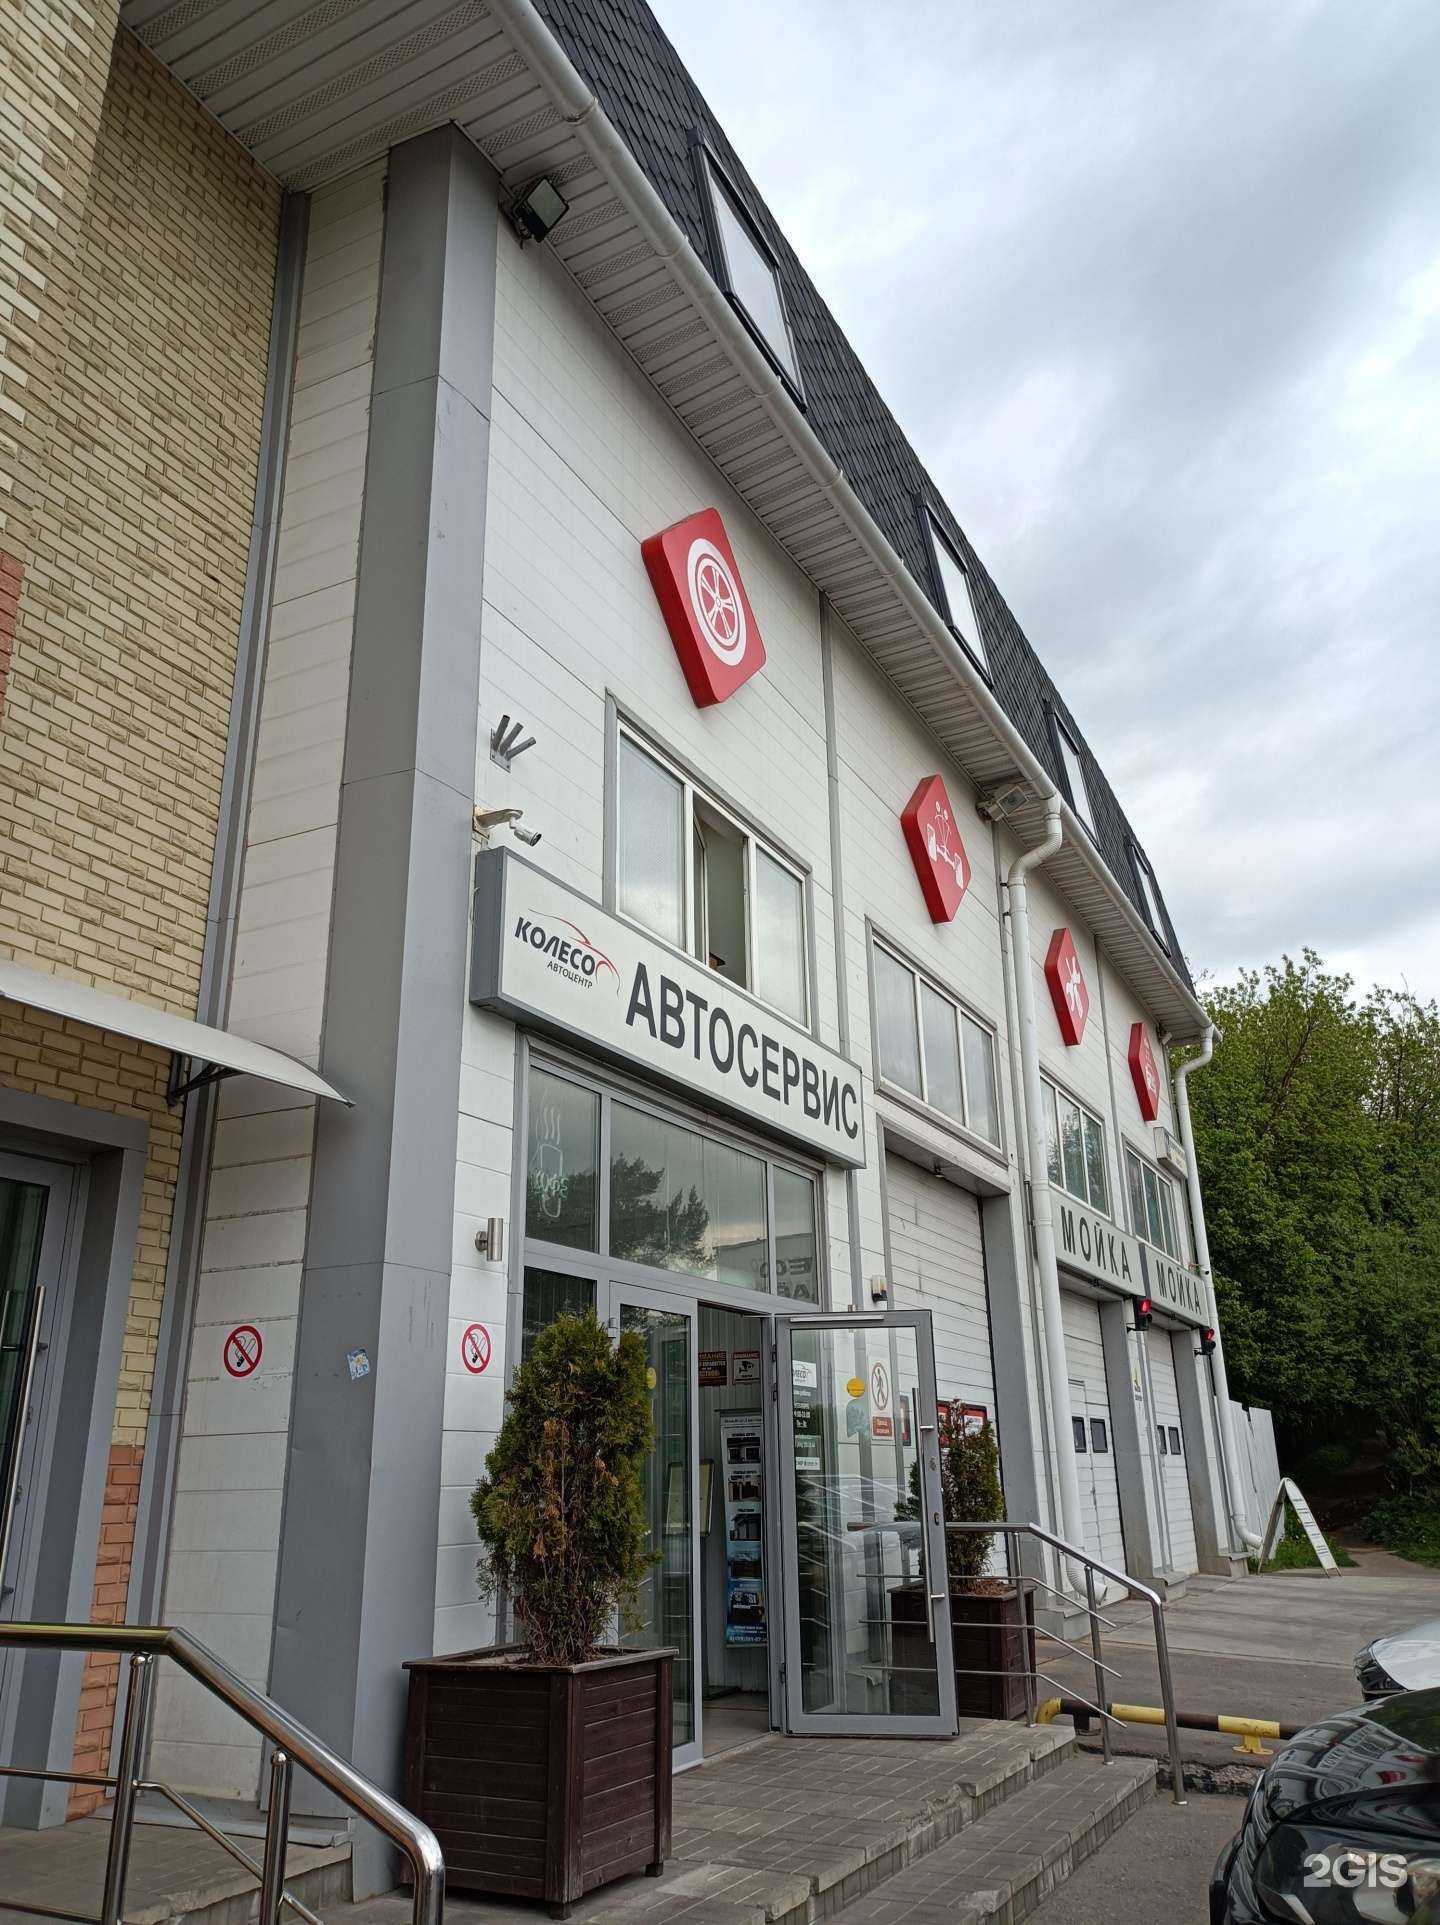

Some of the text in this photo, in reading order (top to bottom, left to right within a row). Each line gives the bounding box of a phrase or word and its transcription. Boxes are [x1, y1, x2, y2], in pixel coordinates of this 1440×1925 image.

[514, 917, 596, 976] КОЛЕСО
[547, 961, 593, 989] АВТОЦЕНТР
[625, 961, 859, 1140] АВТОСЕРВИС
[1060, 1206, 1133, 1283] МОЙКА
[1156, 1259, 1202, 1316] МОЙКА
